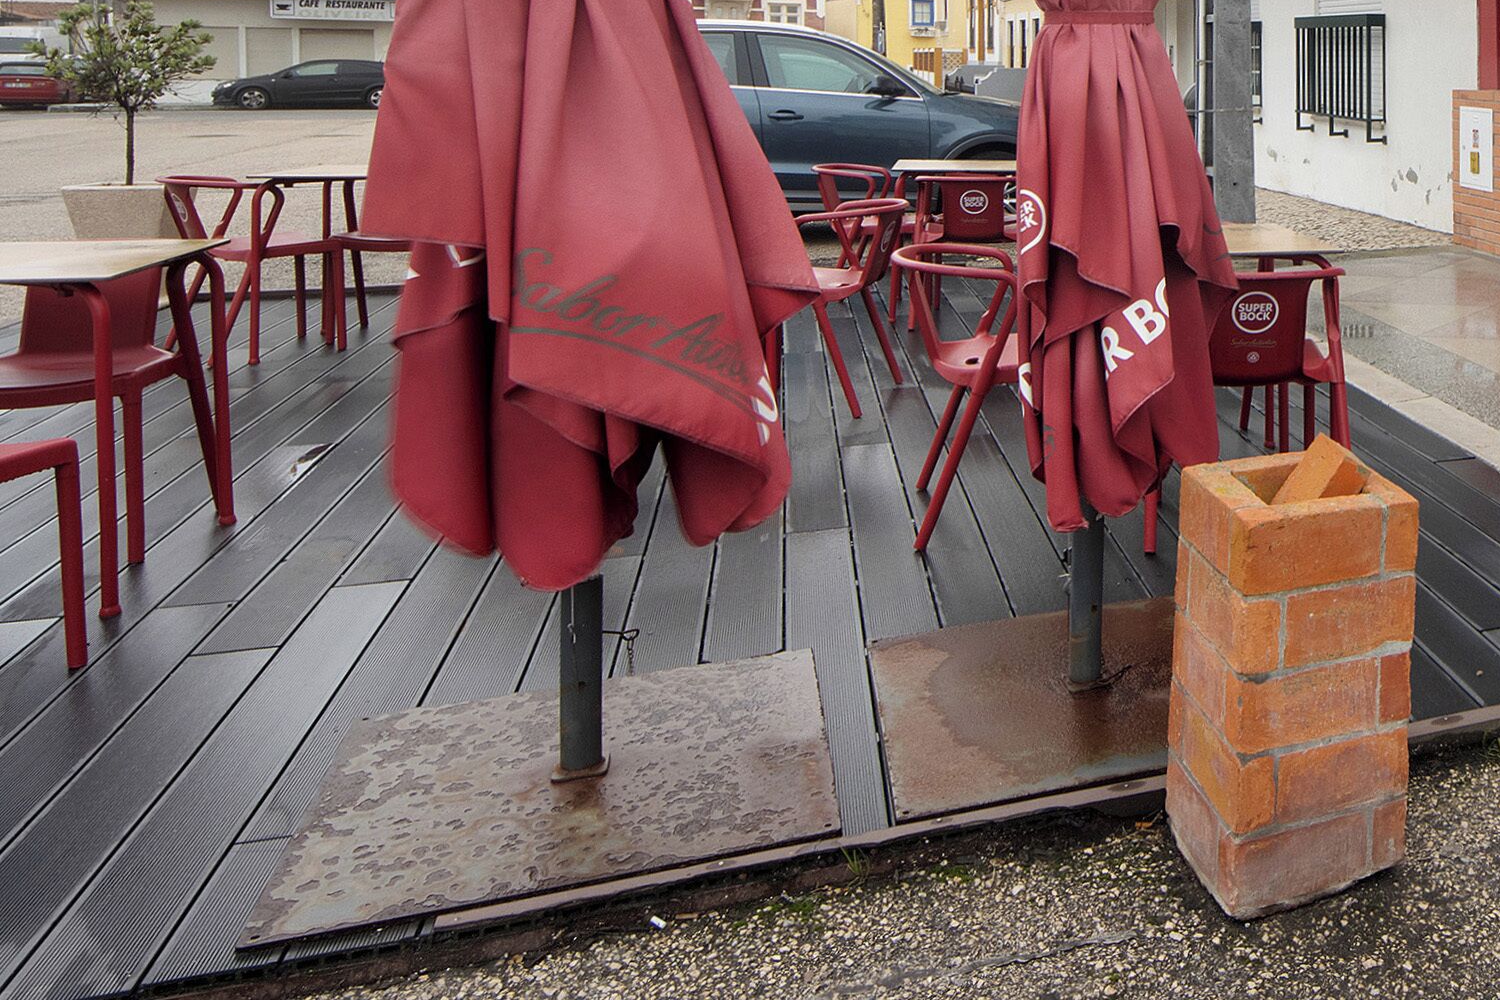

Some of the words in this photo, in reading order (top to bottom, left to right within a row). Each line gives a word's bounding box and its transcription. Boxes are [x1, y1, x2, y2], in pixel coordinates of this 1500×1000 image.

[325, 0, 385, 10] RESTAURANTE
[512, 247, 658, 337] Sabor
[1238, 303, 1273, 312] SUPER
[1239, 312, 1271, 321] BOCK
